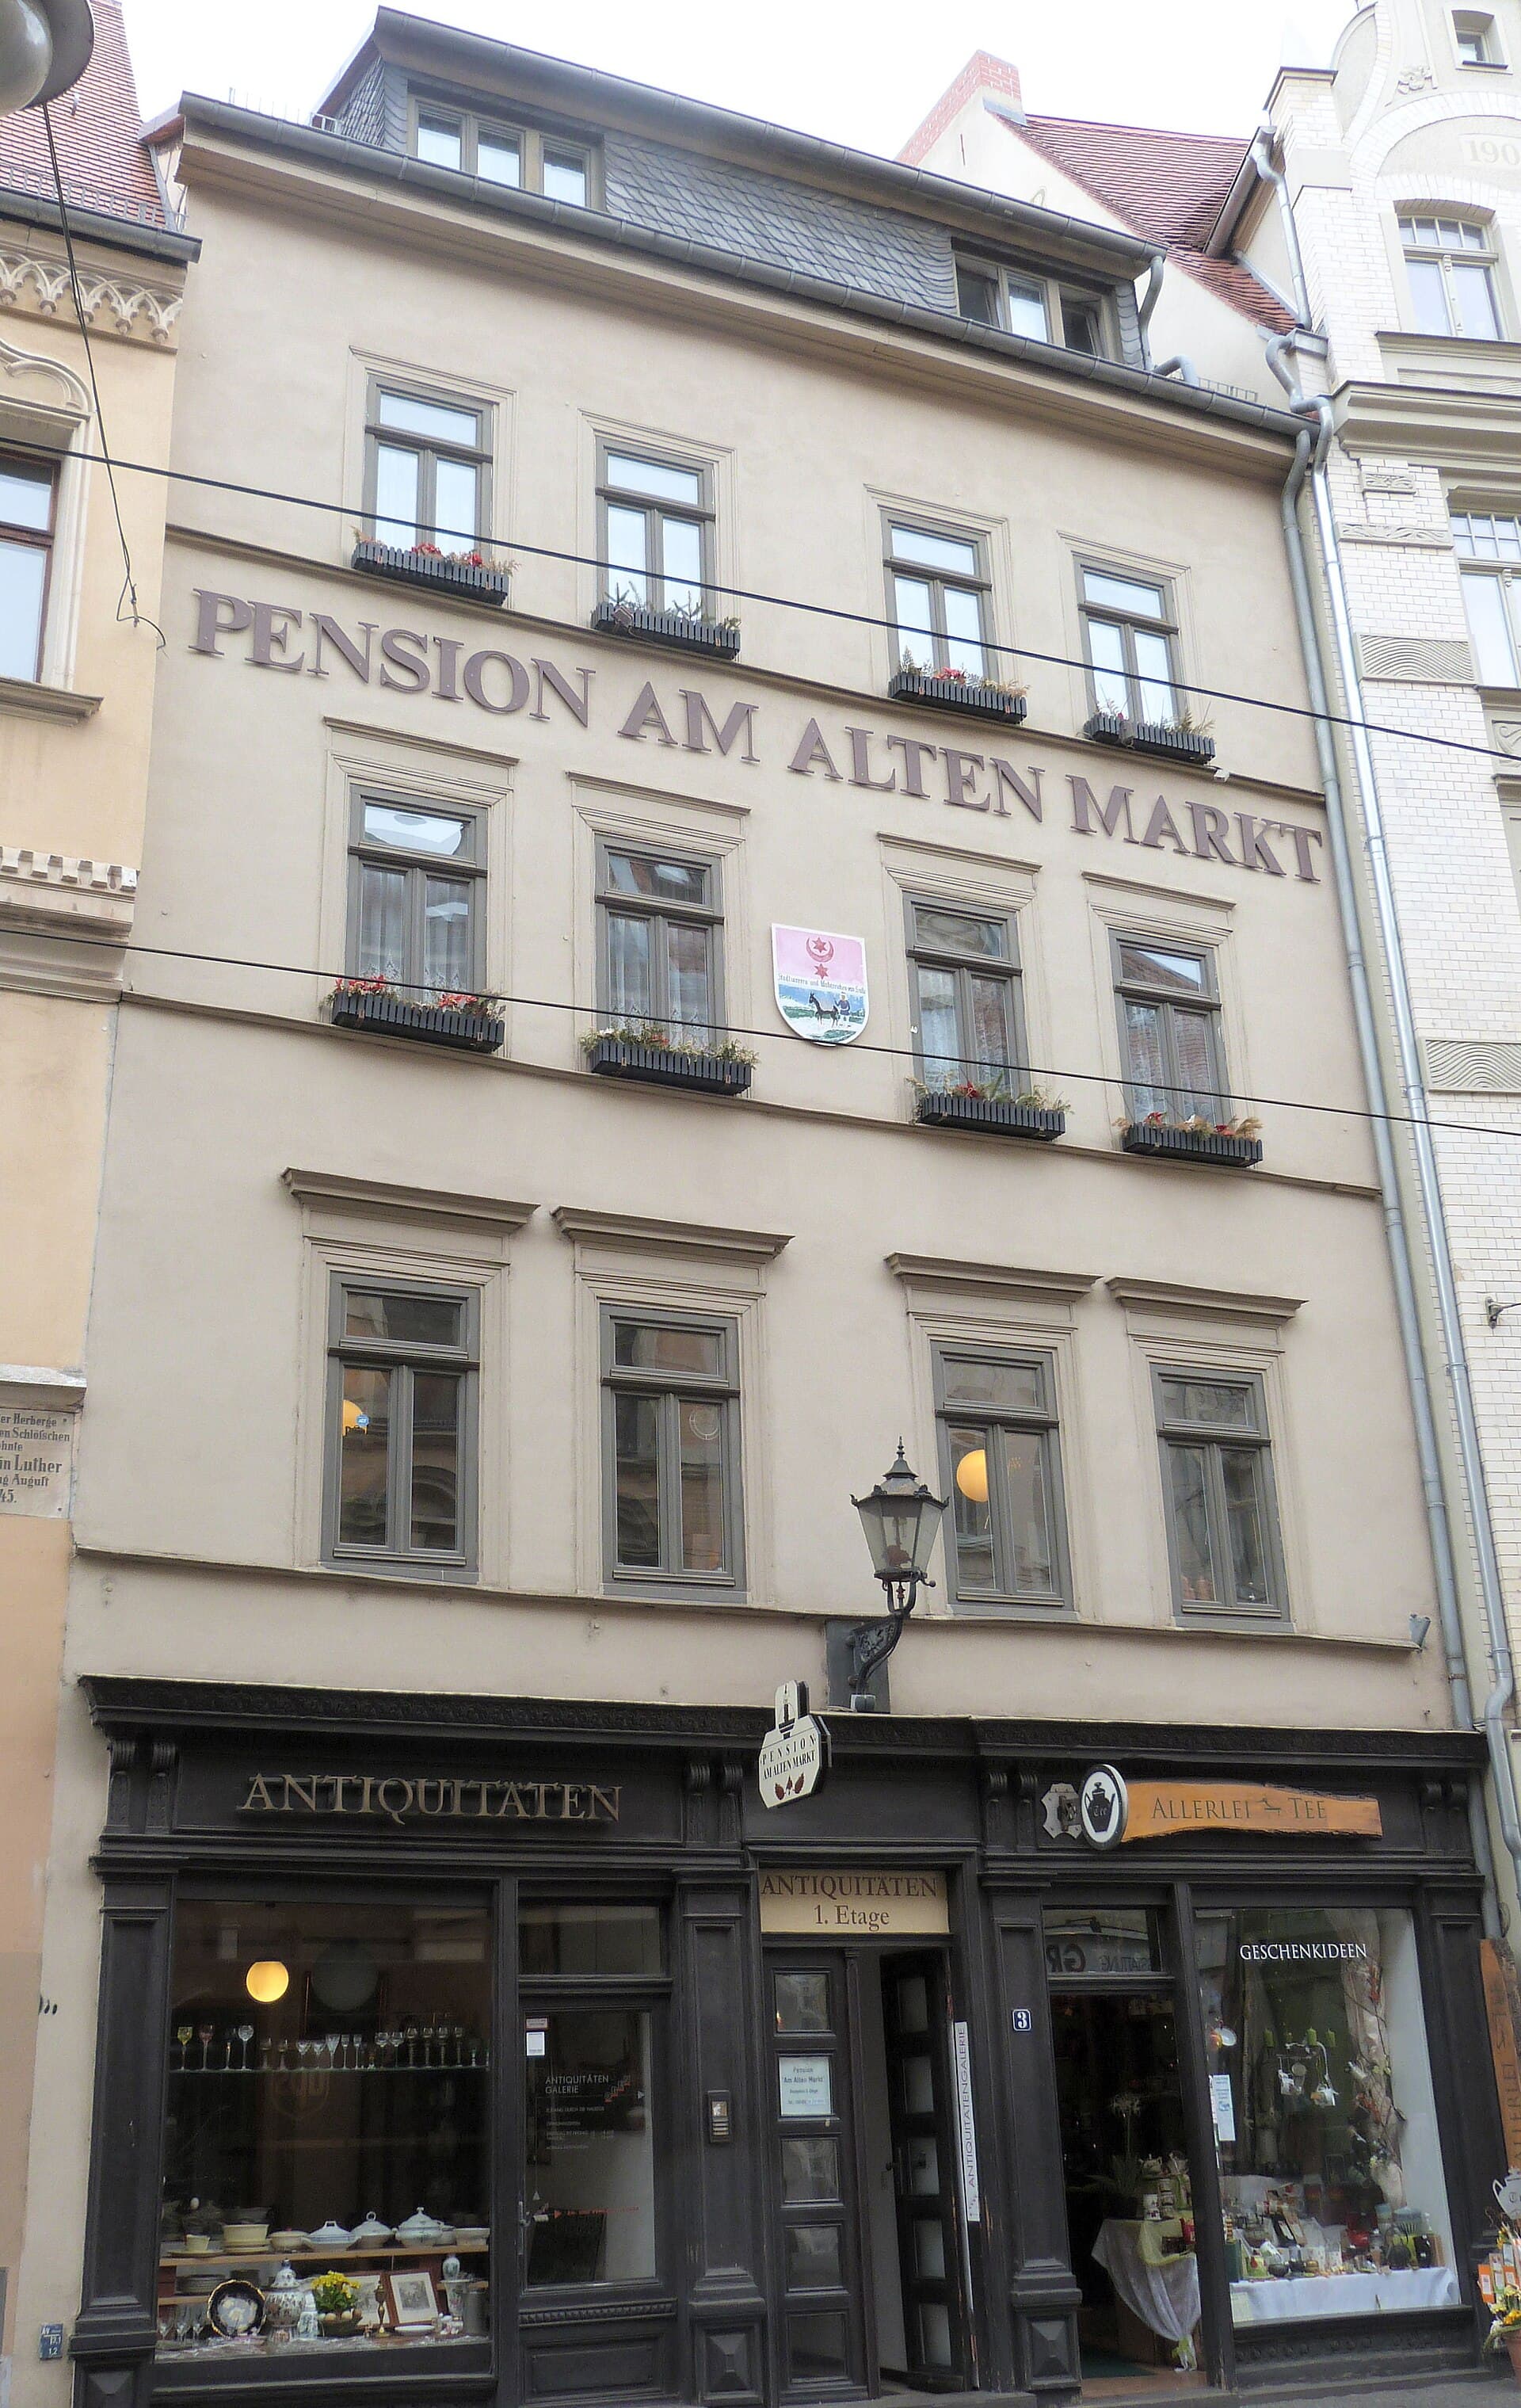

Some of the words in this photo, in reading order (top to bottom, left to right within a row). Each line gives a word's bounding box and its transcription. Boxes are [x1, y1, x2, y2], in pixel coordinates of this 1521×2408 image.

[188, 589, 597, 727] PENSION
[617, 681, 760, 762] AM
[787, 718, 1046, 822] ALTEN
[1065, 773, 1323, 883] MARKT
[13, 1413, 57, 1429] Herberge
[13, 1454, 63, 1473] Luther
[762, 1733, 817, 1765] PENSION
[763, 1767, 772, 1780] AM
[773, 1760, 791, 1776] ALTEN
[792, 1750, 815, 1769] MARKT
[1151, 1797, 1251, 1819] ALLERLEI
[1288, 1797, 1327, 1819] TEE
[760, 1874, 938, 1900] ANTIQUITÄTEN
[814, 1904, 829, 1925] 1.
[834, 1905, 890, 1932] Etage
[1240, 1943, 1367, 1960] GESCHENKIDEEN
[1017, 2011, 1027, 2029] 3
[545, 2085, 579, 2094] GALERIE
